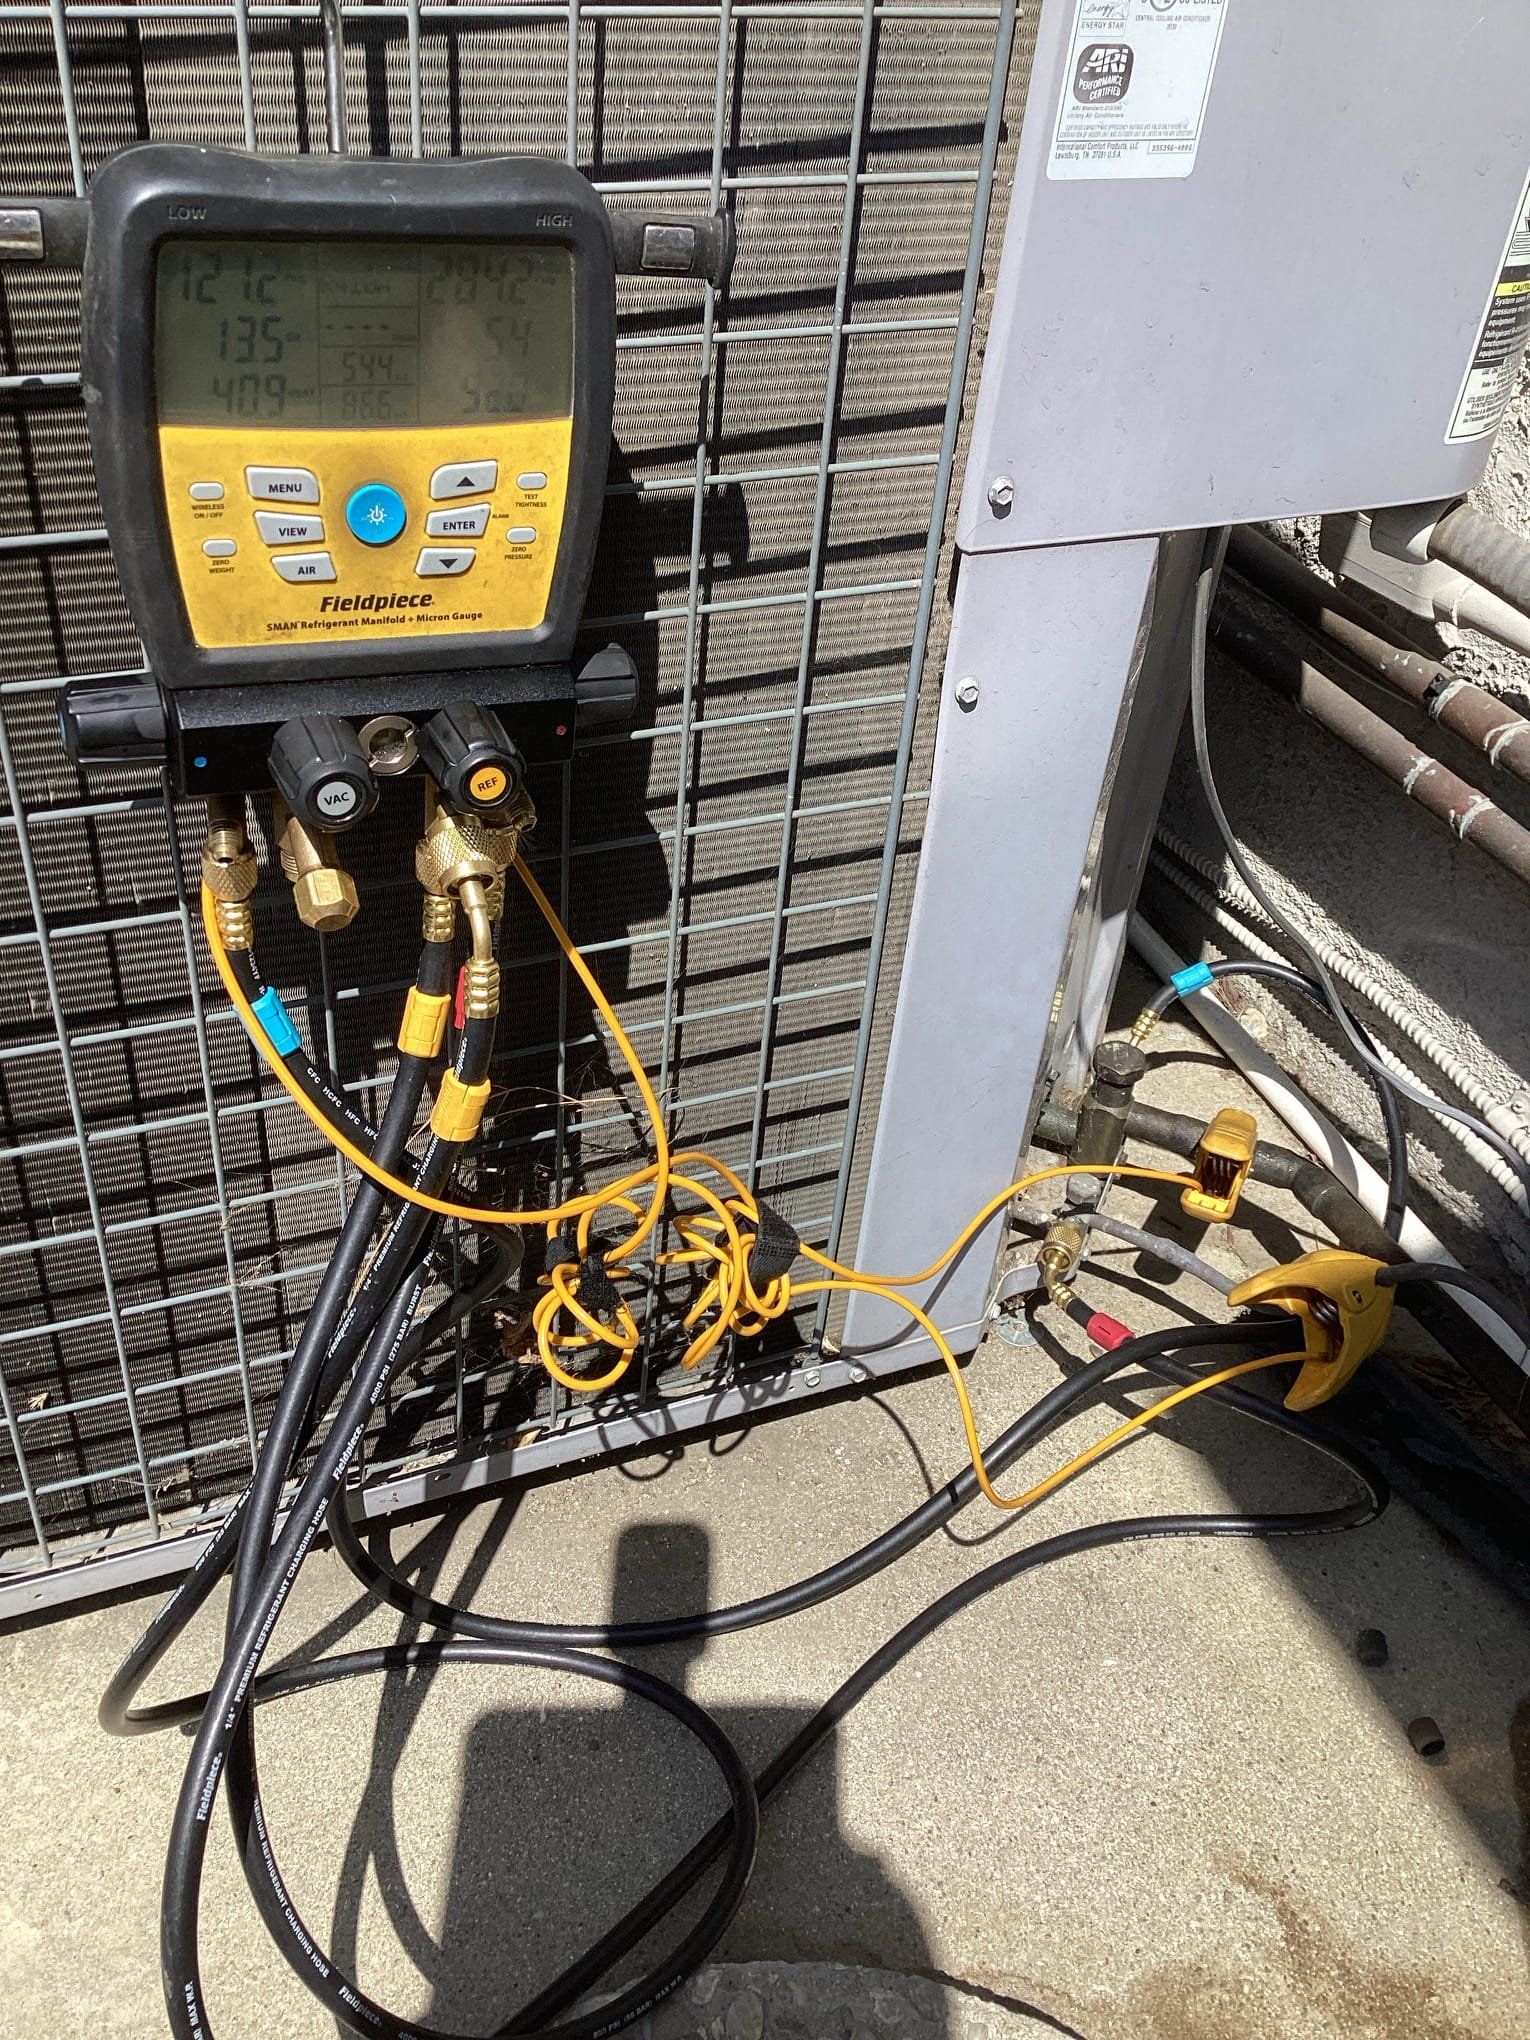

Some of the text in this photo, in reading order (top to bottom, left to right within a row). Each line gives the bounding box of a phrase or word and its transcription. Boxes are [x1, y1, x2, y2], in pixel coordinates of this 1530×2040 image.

[1081, 21, 1125, 29] ENERGY STAR
[1082, 48, 1129, 73] ARI
[1079, 75, 1123, 90] PERFORMANCE
[1089, 86, 1121, 101] CERTIFIED
[1057, 143, 1087, 151] International
[168, 207, 208, 220] LOW
[535, 214, 574, 227] HIGH
[268, 484, 303, 494] MENU
[278, 527, 308, 537] VIEW
[443, 521, 476, 531] ENTER
[297, 566, 317, 575] AIR
[319, 593, 433, 613] Fieldpiece
[300, 618, 359, 630] Refrigerant
[361, 615, 406, 626] Manifold
[416, 613, 451, 623] Micron
[452, 611, 484, 621] Gauge
[476, 776, 499, 793] REF
[322, 791, 350, 807] VAC
[307, 1067, 321, 1084] CFC
[322, 1086, 343, 1108] HCFC
[344, 1108, 361, 1125] HFC
[373, 1231, 396, 1273] PREMIUM
[369, 1283, 422, 1405] 4000 PSI (275 BAR) BURST
[234, 1651, 259, 1703] PREMIUM
[254, 1578, 290, 1651] REFRIGERANT
[286, 1526, 315, 1578] CHARGING
[311, 1496, 329, 1531] HOSE
[332, 1424, 364, 1481] Fieldpiece
[196, 1752, 223, 1822] Fieldpiece
[261, 1842, 288, 1908] REFRIGERANT
[284, 1907, 312, 1956] CHARGING
[310, 1954, 330, 1978] HOSE
[187, 2002, 199, 2027] MAX
